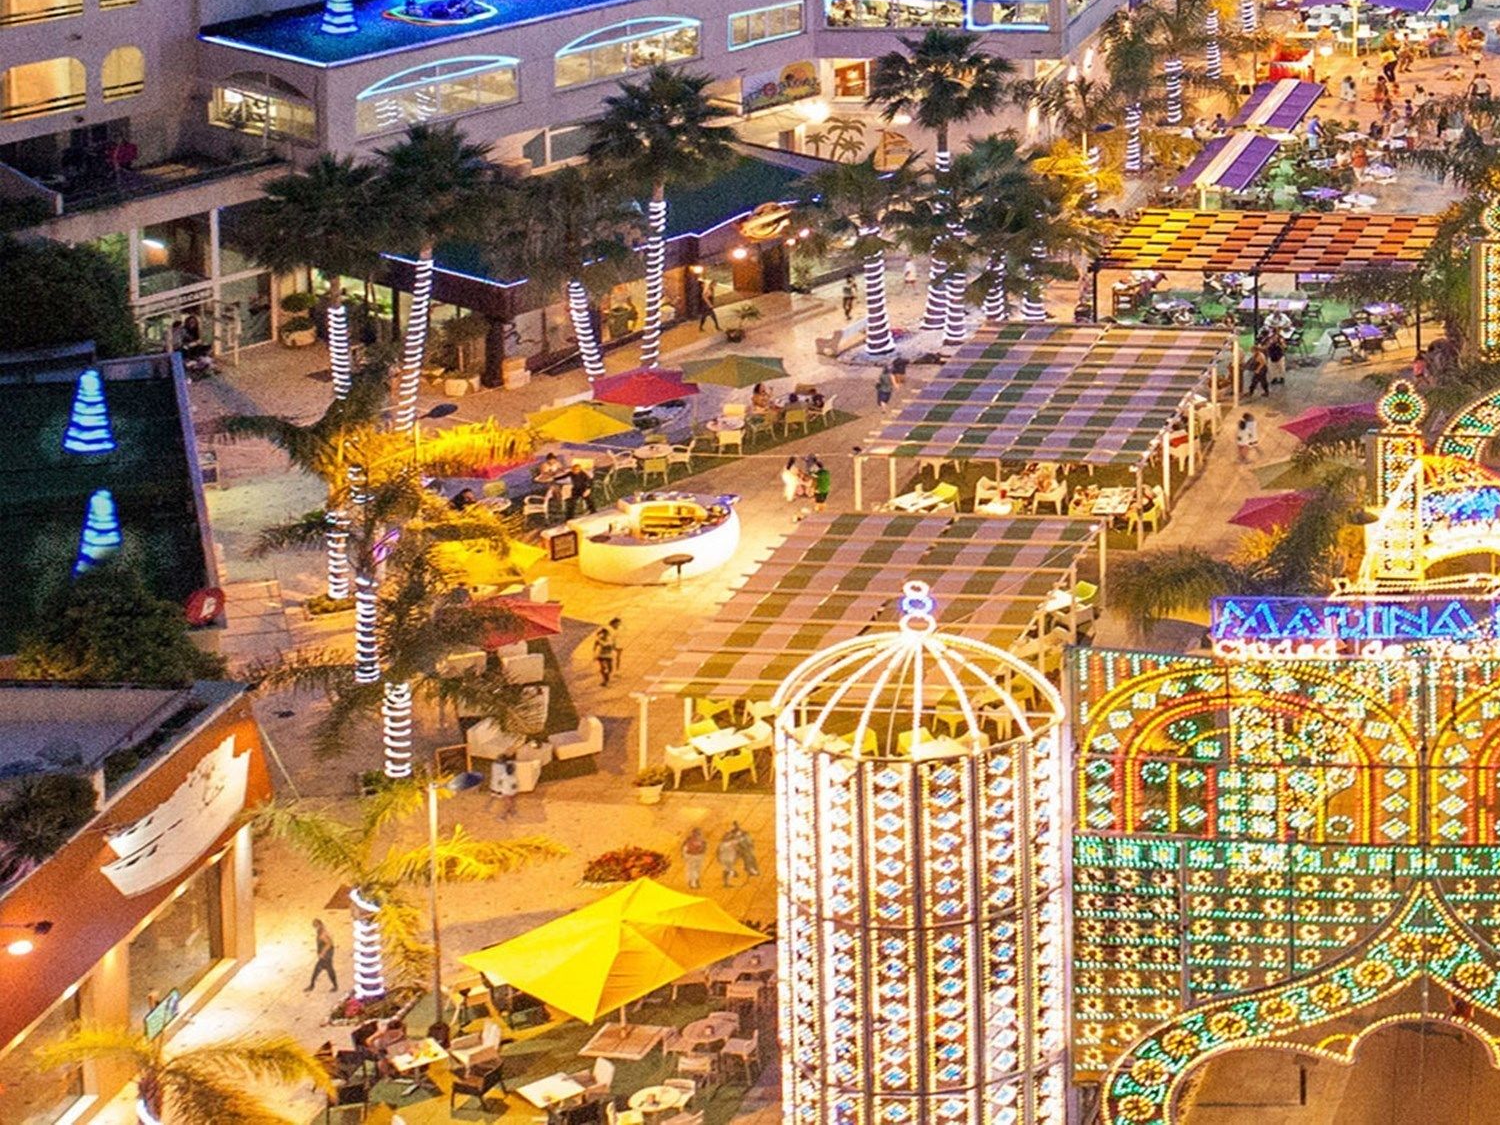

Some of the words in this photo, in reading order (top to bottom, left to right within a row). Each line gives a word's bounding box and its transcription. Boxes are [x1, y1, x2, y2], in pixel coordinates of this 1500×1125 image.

[1214, 601, 1477, 641] MARINA
[1214, 638, 1341, 660] Ciudad
[1362, 639, 1406, 660] de
